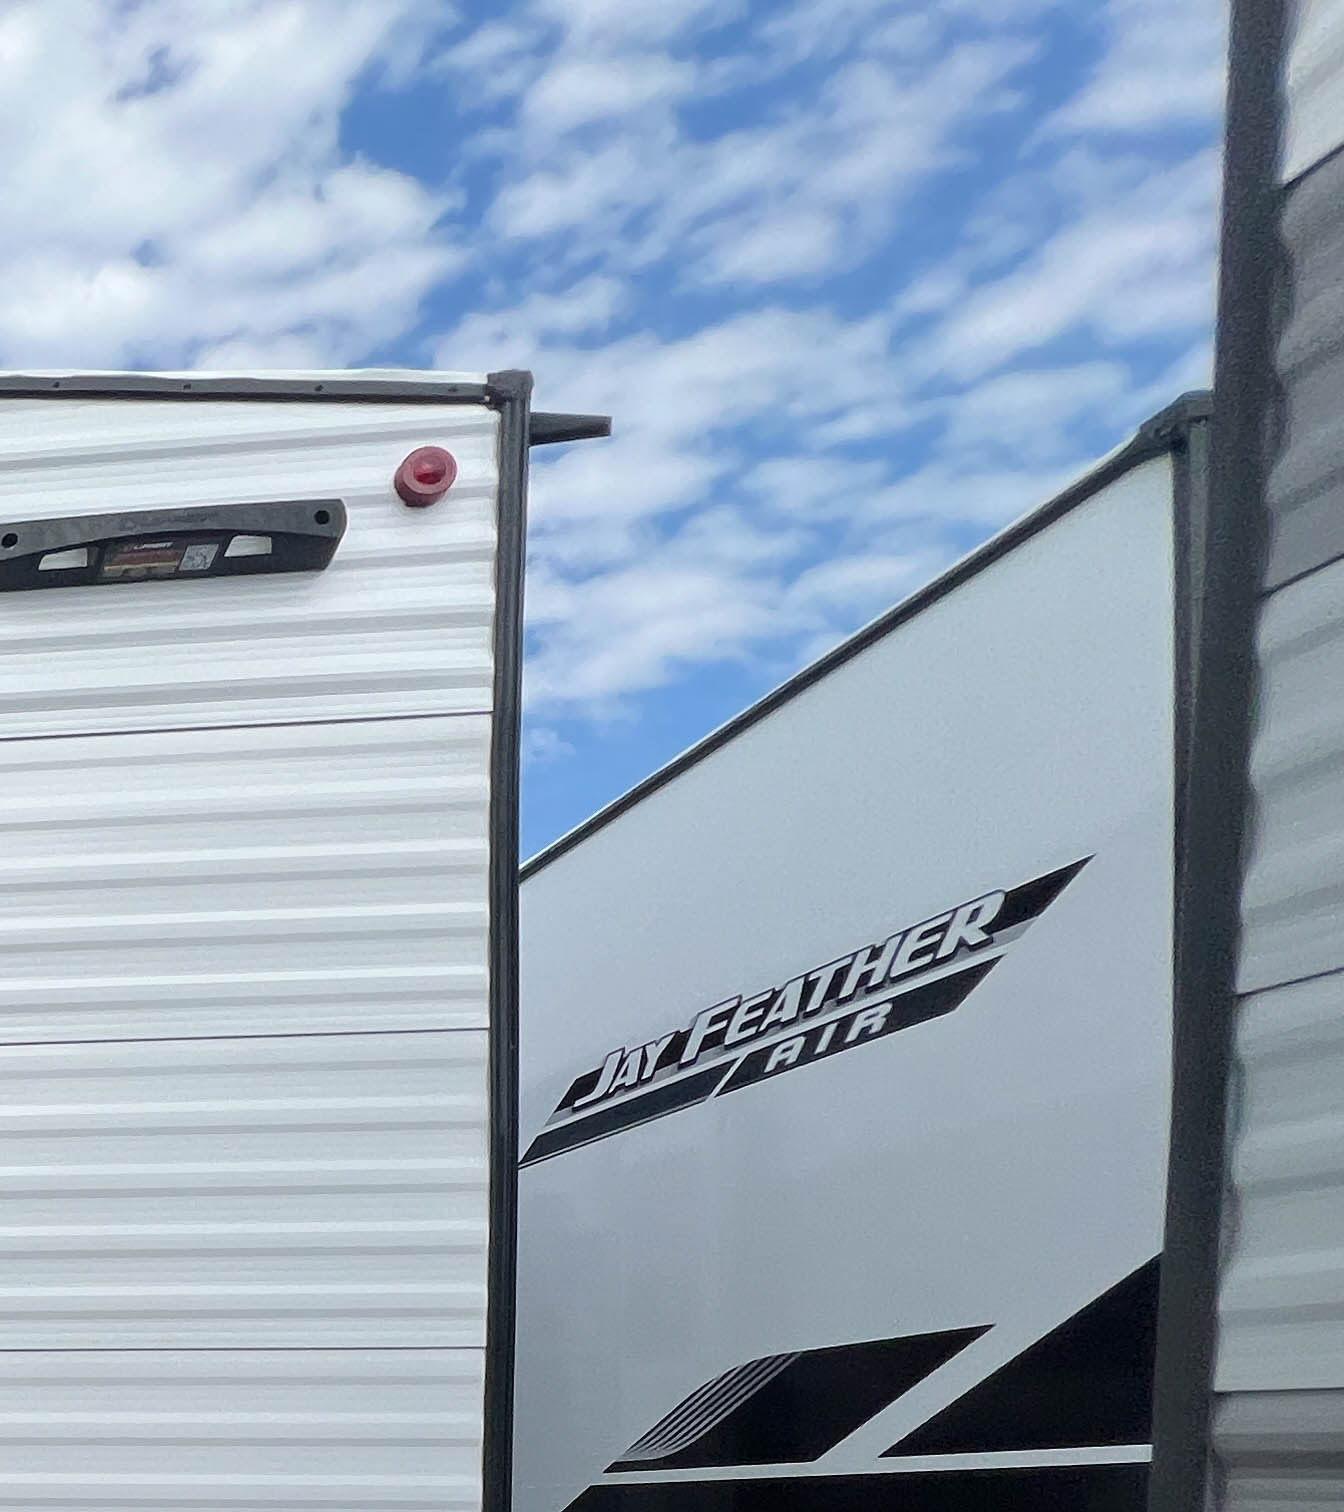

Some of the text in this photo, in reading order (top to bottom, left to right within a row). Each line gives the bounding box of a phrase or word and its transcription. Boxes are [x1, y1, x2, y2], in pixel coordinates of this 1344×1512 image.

[572, 889, 1006, 1110] JAY FEATHER
[765, 1003, 894, 1073] AIR
